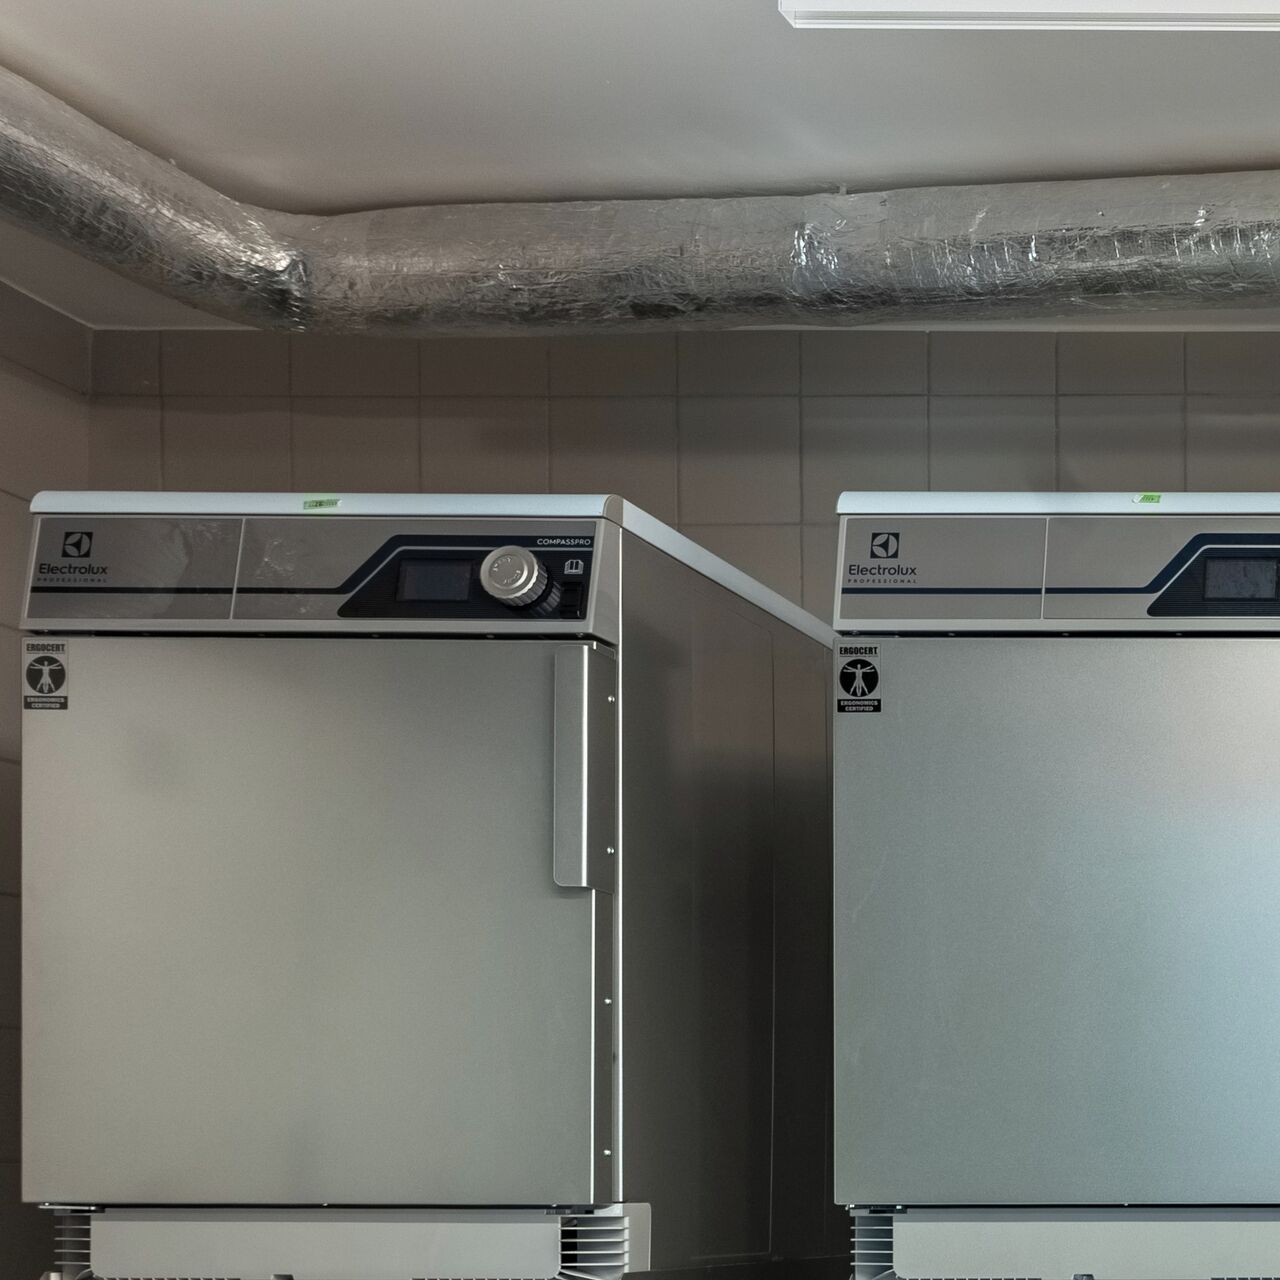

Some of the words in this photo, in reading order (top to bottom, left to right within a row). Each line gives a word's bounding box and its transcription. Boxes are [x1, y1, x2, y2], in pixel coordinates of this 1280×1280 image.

[39, 563, 108, 577] Electrolux
[848, 563, 917, 577] Electrolux
[839, 646, 878, 655] ERGOCERT
